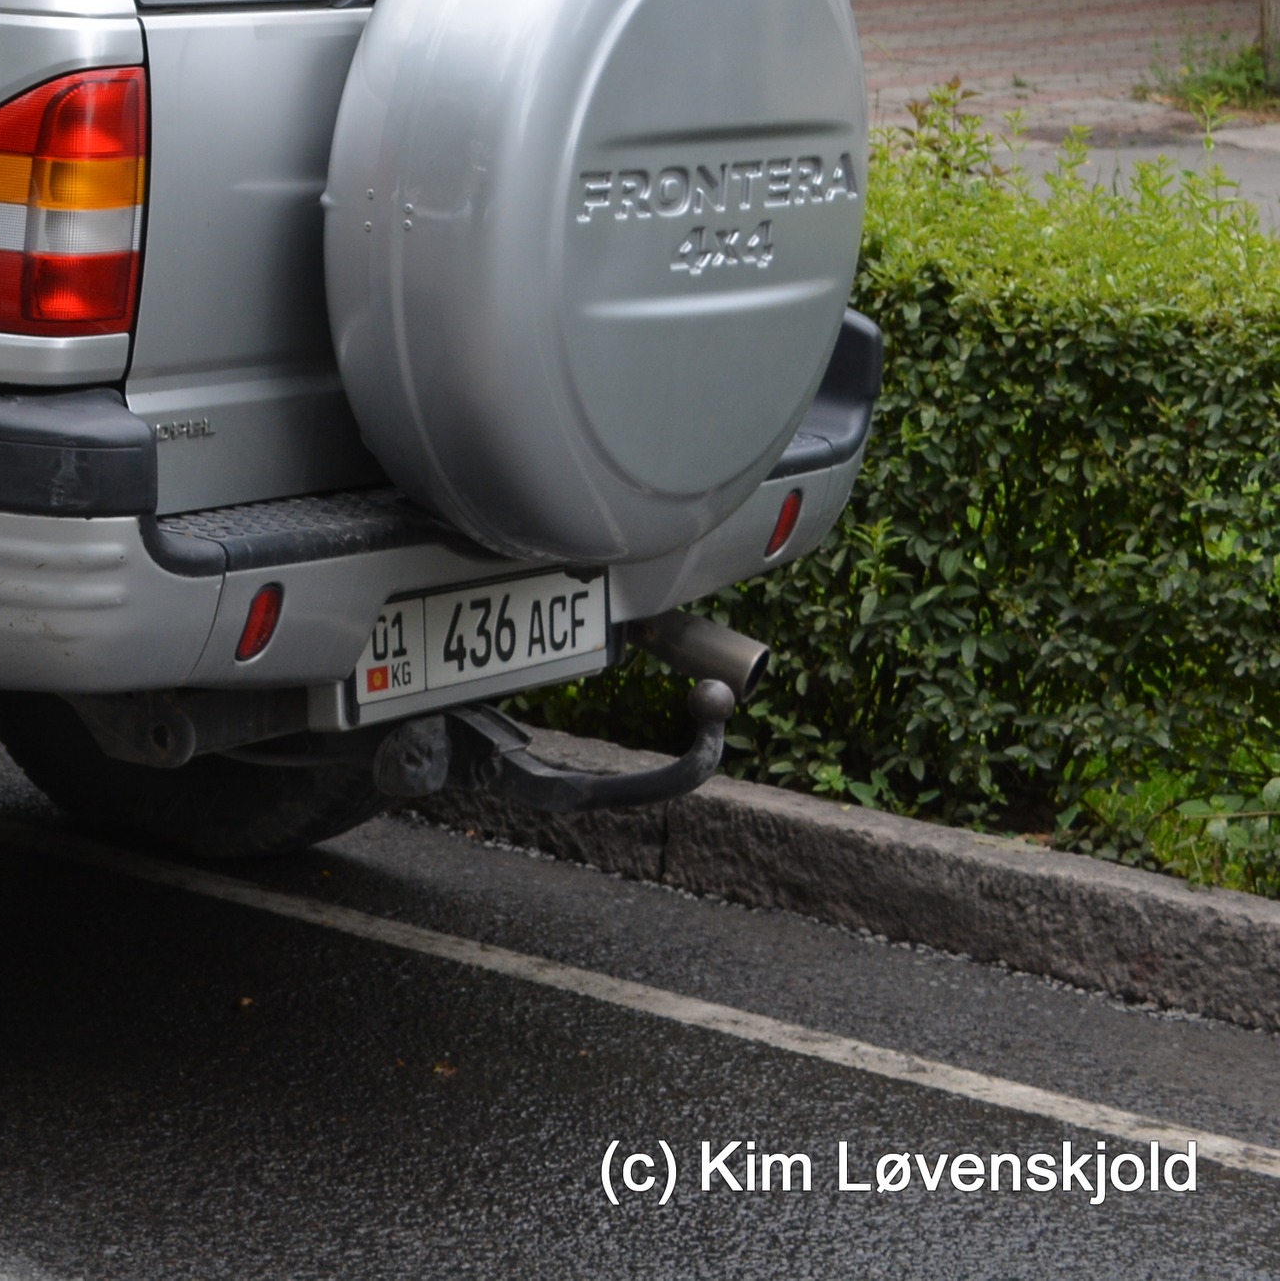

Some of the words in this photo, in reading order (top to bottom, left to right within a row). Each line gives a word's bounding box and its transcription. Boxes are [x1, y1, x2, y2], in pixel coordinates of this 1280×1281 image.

[576, 152, 858, 222] FRONTERA
[372, 611, 407, 661] 01
[443, 593, 516, 672] 436
[528, 590, 589, 658] ACF
[391, 662, 412, 688] KG
